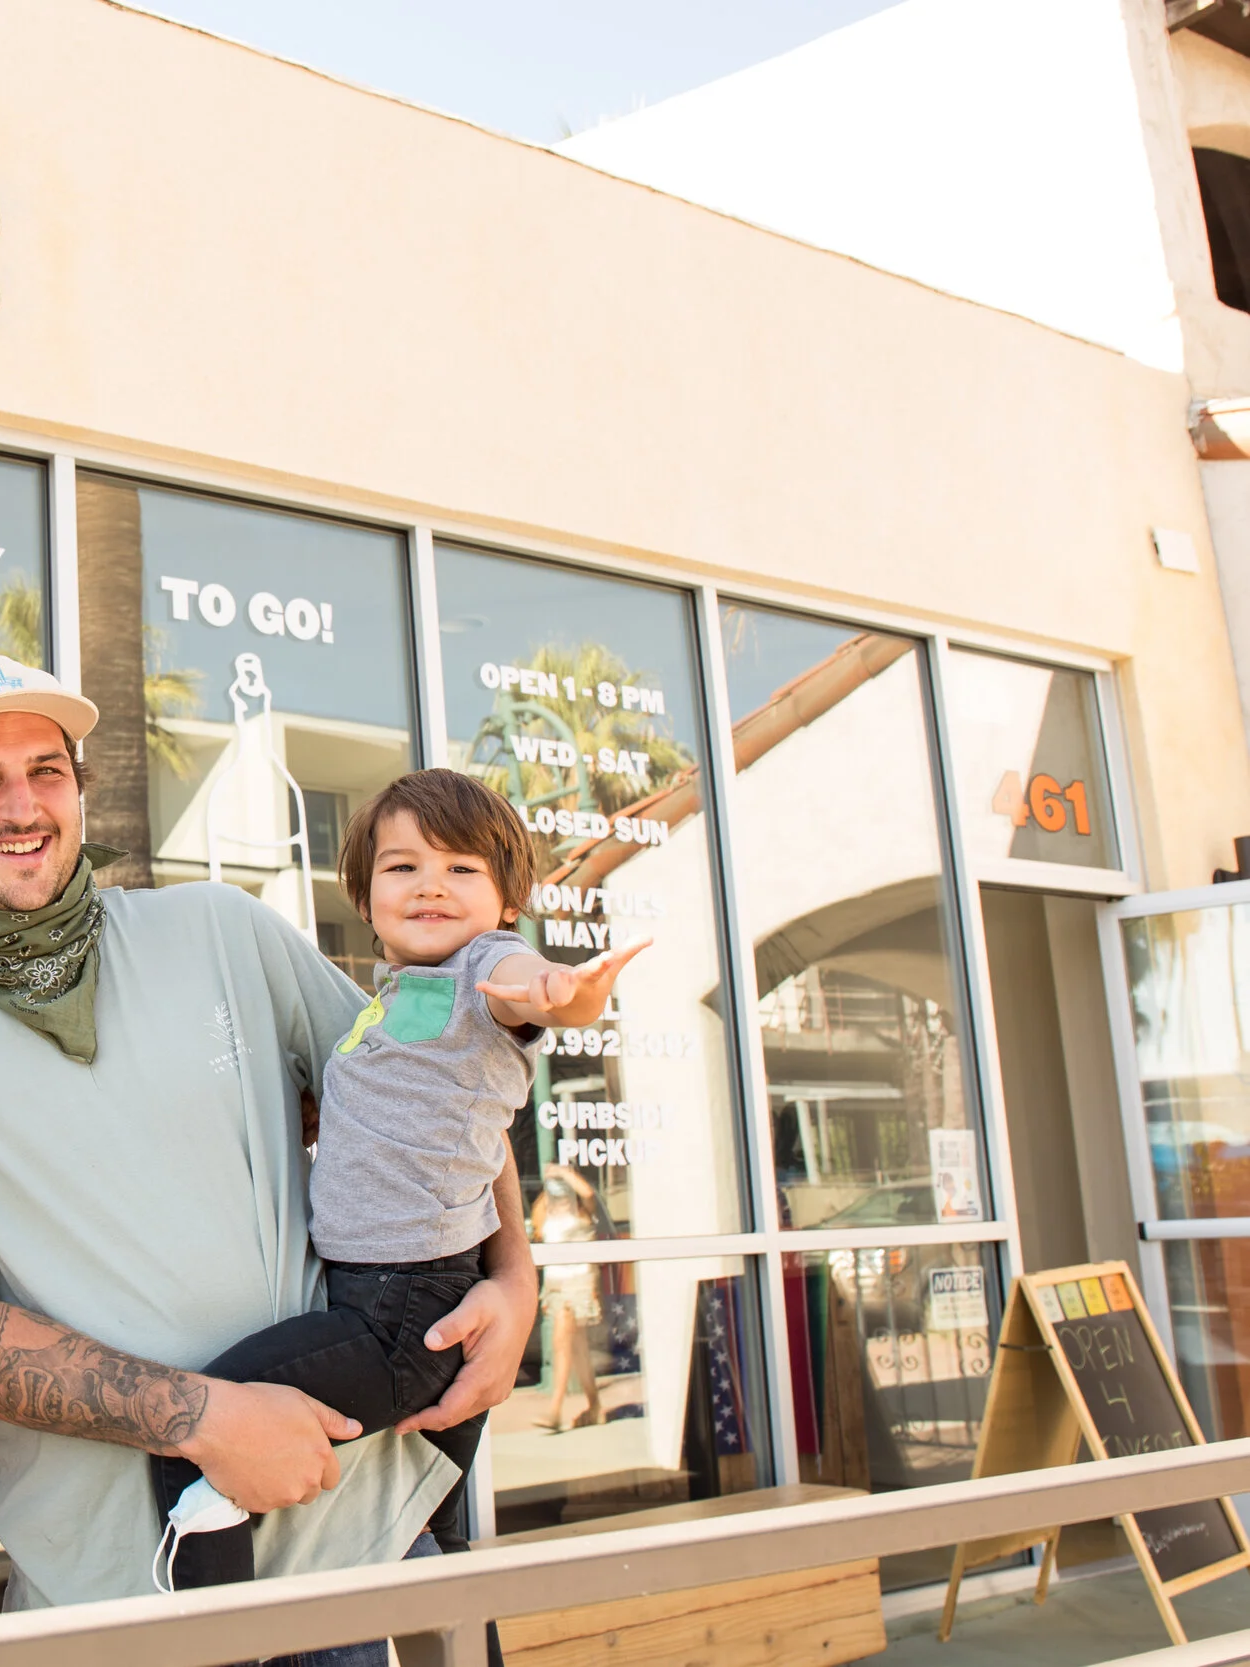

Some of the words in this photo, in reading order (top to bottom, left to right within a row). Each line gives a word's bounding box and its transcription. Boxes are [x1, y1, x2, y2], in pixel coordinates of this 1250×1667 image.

[161, 575, 237, 627] TO
[248, 591, 334, 644] GO!
[479, 662, 558, 699] OPEN
[562, 676, 577, 702] 1
[582, 688, 594, 697] -
[597, 681, 618, 708] 8
[621, 685, 666, 715] PM
[510, 735, 578, 769] WED
[597, 747, 651, 779] SAT
[991, 769, 1091, 836] 461
[518, 805, 611, 840] LOSED
[614, 815, 669, 847] SUN
[538, 1101, 676, 1130] CURBSIDE
[558, 1138, 662, 1167] PICKUP
[934, 1274, 981, 1292] NOTICE
[1060, 1325, 1134, 1371] OPEN
[1099, 1380, 1135, 1424] 4
